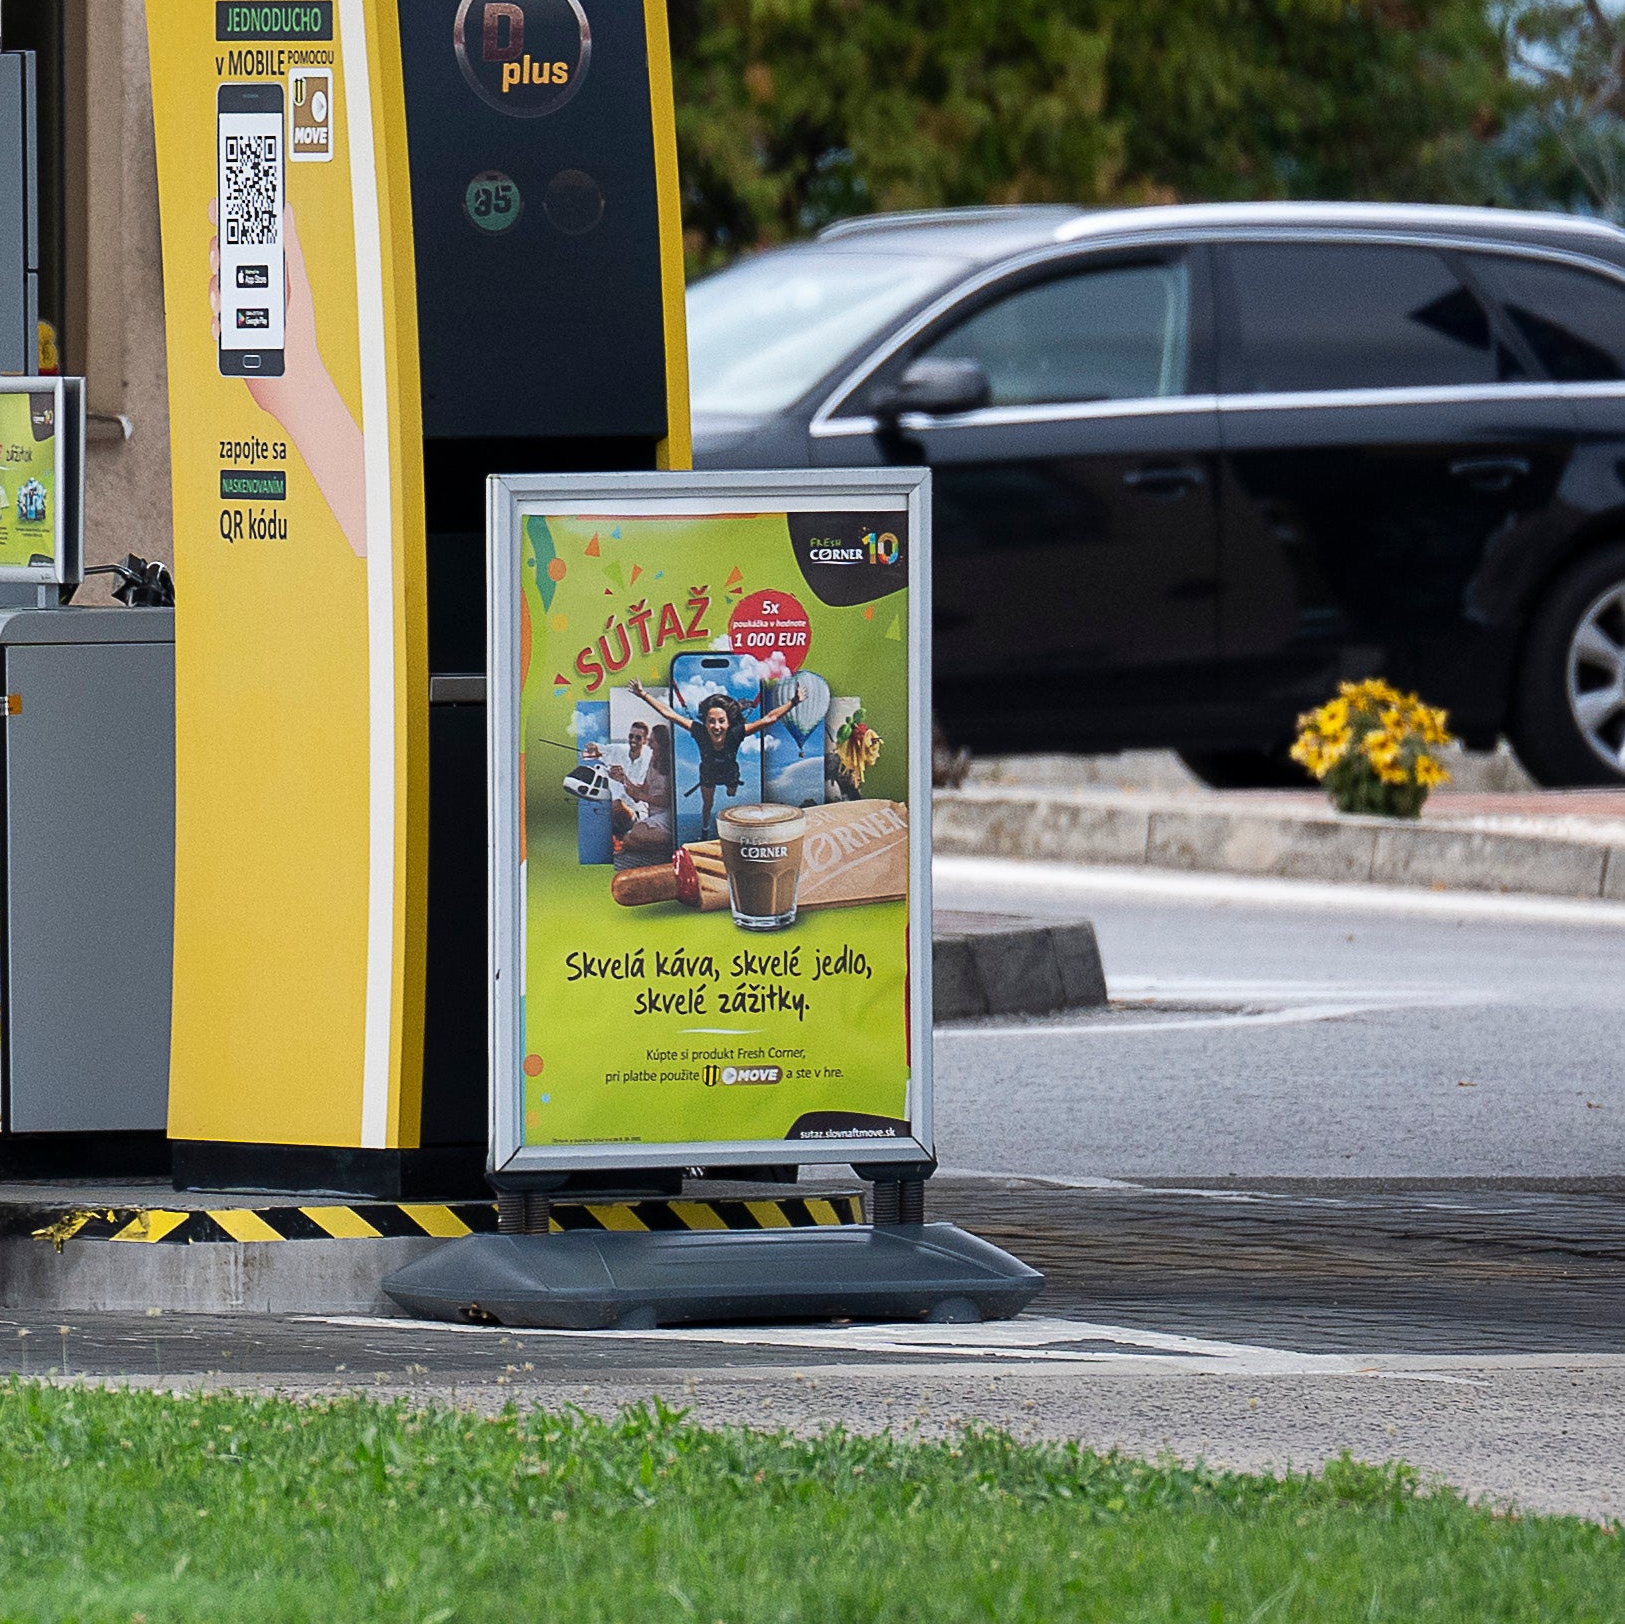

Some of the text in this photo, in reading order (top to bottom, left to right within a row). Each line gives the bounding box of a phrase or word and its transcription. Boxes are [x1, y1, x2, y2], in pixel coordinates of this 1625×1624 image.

[227, 7, 323, 33] JEDNODUCHO
[481, 2, 525, 63] D
[215, 49, 285, 76] v MOBILE
[287, 49, 335, 65] POMOCOU
[502, 54, 569, 93] plus
[294, 126, 328, 145] MOVE
[219, 435, 288, 465] zapojte sa
[221, 475, 285, 495] NASKENOVANÍM
[219, 507, 288, 544] QR kódu
[810, 537, 842, 548] FRESH
[861, 531, 901, 567] 10
[809, 548, 864, 562] CORNER
[762, 600, 780, 616] 5x
[575, 584, 711, 693] SÚŤAŽ
[734, 630, 807, 648] 1 000 EUR
[740, 846, 789, 859] CORNER
[565, 943, 873, 982] Skvelá káva, skvelé jedlo,
[633, 982, 811, 1022] skvelé zážitky.
[645, 1046, 807, 1063] Kúpte si produkt Fresh Corner,
[605, 1066, 845, 1085] pri platbe použite MOVE a ste v hre.
